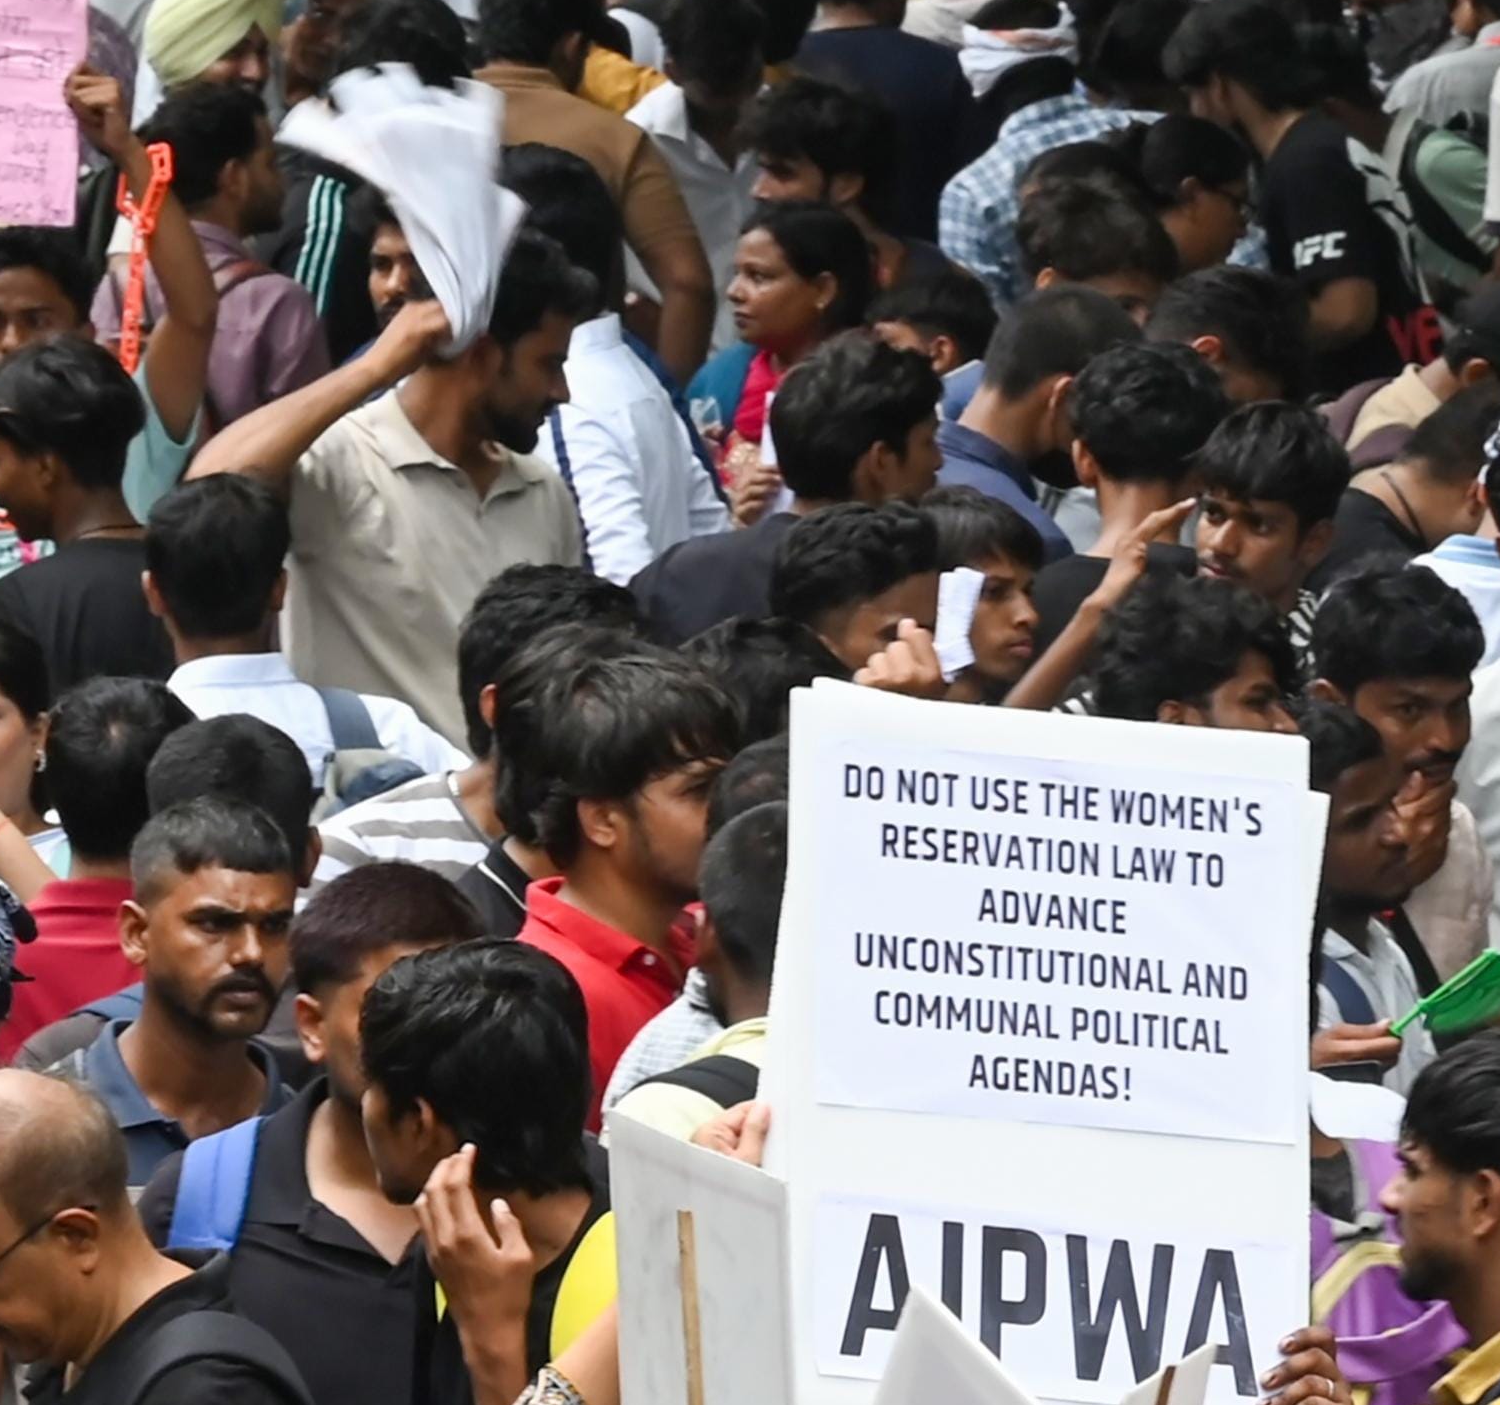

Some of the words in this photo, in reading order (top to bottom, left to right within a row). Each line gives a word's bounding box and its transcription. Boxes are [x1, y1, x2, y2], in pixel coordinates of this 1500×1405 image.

[843, 762, 886, 802] DO
[895, 768, 959, 808] NOT
[970, 776, 1029, 814] USE
[1040, 783, 1099, 820] THE
[1110, 788, 1264, 837] WOMEN'S
[880, 823, 1101, 877] RESERVATION
[1111, 843, 1177, 883] LAW
[1186, 850, 1226, 889] TO
[978, 888, 1127, 935] ADVANCE
[853, 932, 1173, 996] UNCONSTITUTIONAL
[1182, 961, 1248, 1001] AND
[873, 989, 1061, 1041] COMMUNAL
[1070, 1007, 1229, 1056] POLITICAL
[969, 1053, 1132, 1103] AGENDAS!
[839, 1212, 1260, 1398] AIPWA
